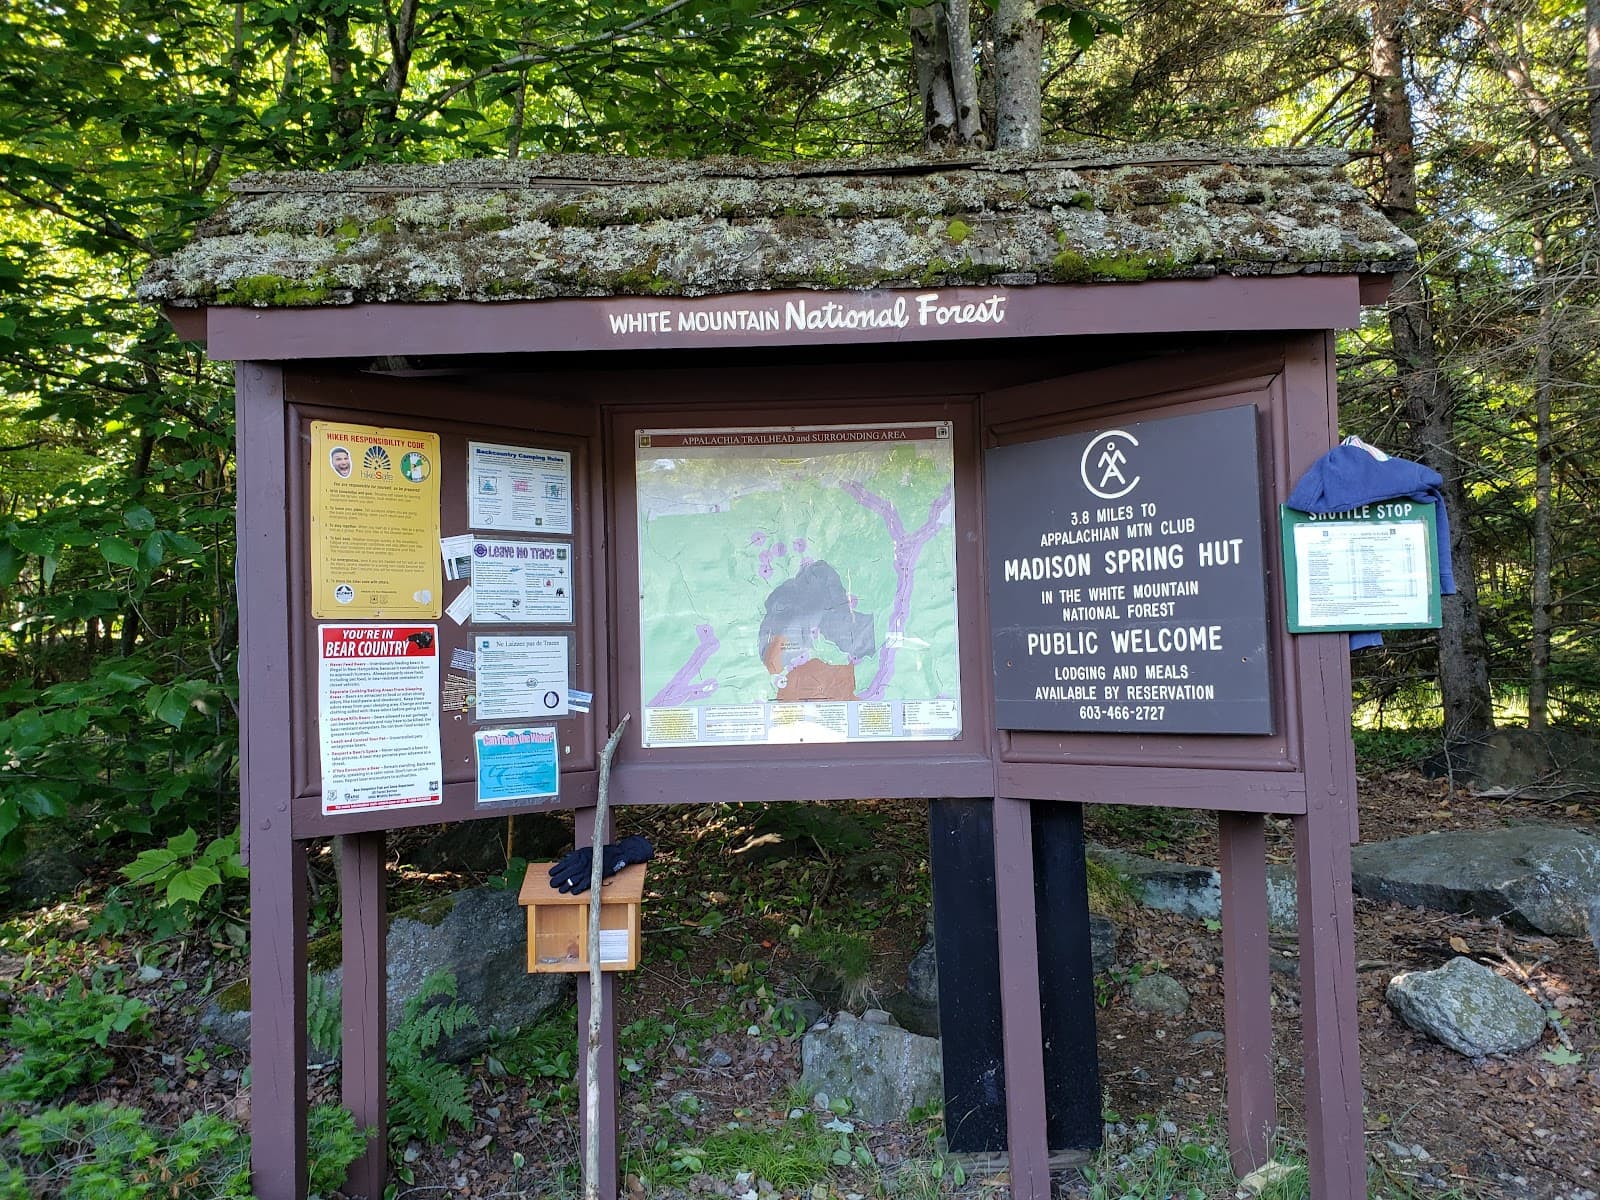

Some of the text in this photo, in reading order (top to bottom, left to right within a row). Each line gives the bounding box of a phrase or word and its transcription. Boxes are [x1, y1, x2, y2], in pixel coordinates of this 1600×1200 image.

[609, 294, 1006, 334] WHITE MOUNTAIN National Forest
[326, 432, 425, 449] HIKER RESPONSIBILITY CODE
[682, 431, 906, 445] APPALACHIA TRAILHEAD and SURROUNDING AREA
[476, 448, 517, 459] Backcountry
[518, 453, 546, 462] Camping
[1071, 503, 1157, 525] 3.8 MILES TO
[1377, 503, 1413, 519] STOP
[1040, 518, 1195, 547] APPALACHIAN MTN CLUB
[488, 545, 555, 560] Leave No Trace
[1004, 538, 1243, 582] MADISON SPRING HUT
[1041, 580, 1199, 605] IN THE WHITE MOUNTAIN
[1062, 602, 1175, 622] NATIONAL FOREST
[342, 629, 394, 639] YOU'RE IN
[1027, 625, 1223, 655] PUBLIC WELCOME
[325, 640, 410, 657] BEAR COUNTRY
[1054, 664, 1188, 680] LODGING AND MEALS
[1035, 685, 1214, 700] AVAILABLE BY RESERVATION
[1079, 706, 1165, 721] 603-466-2727
